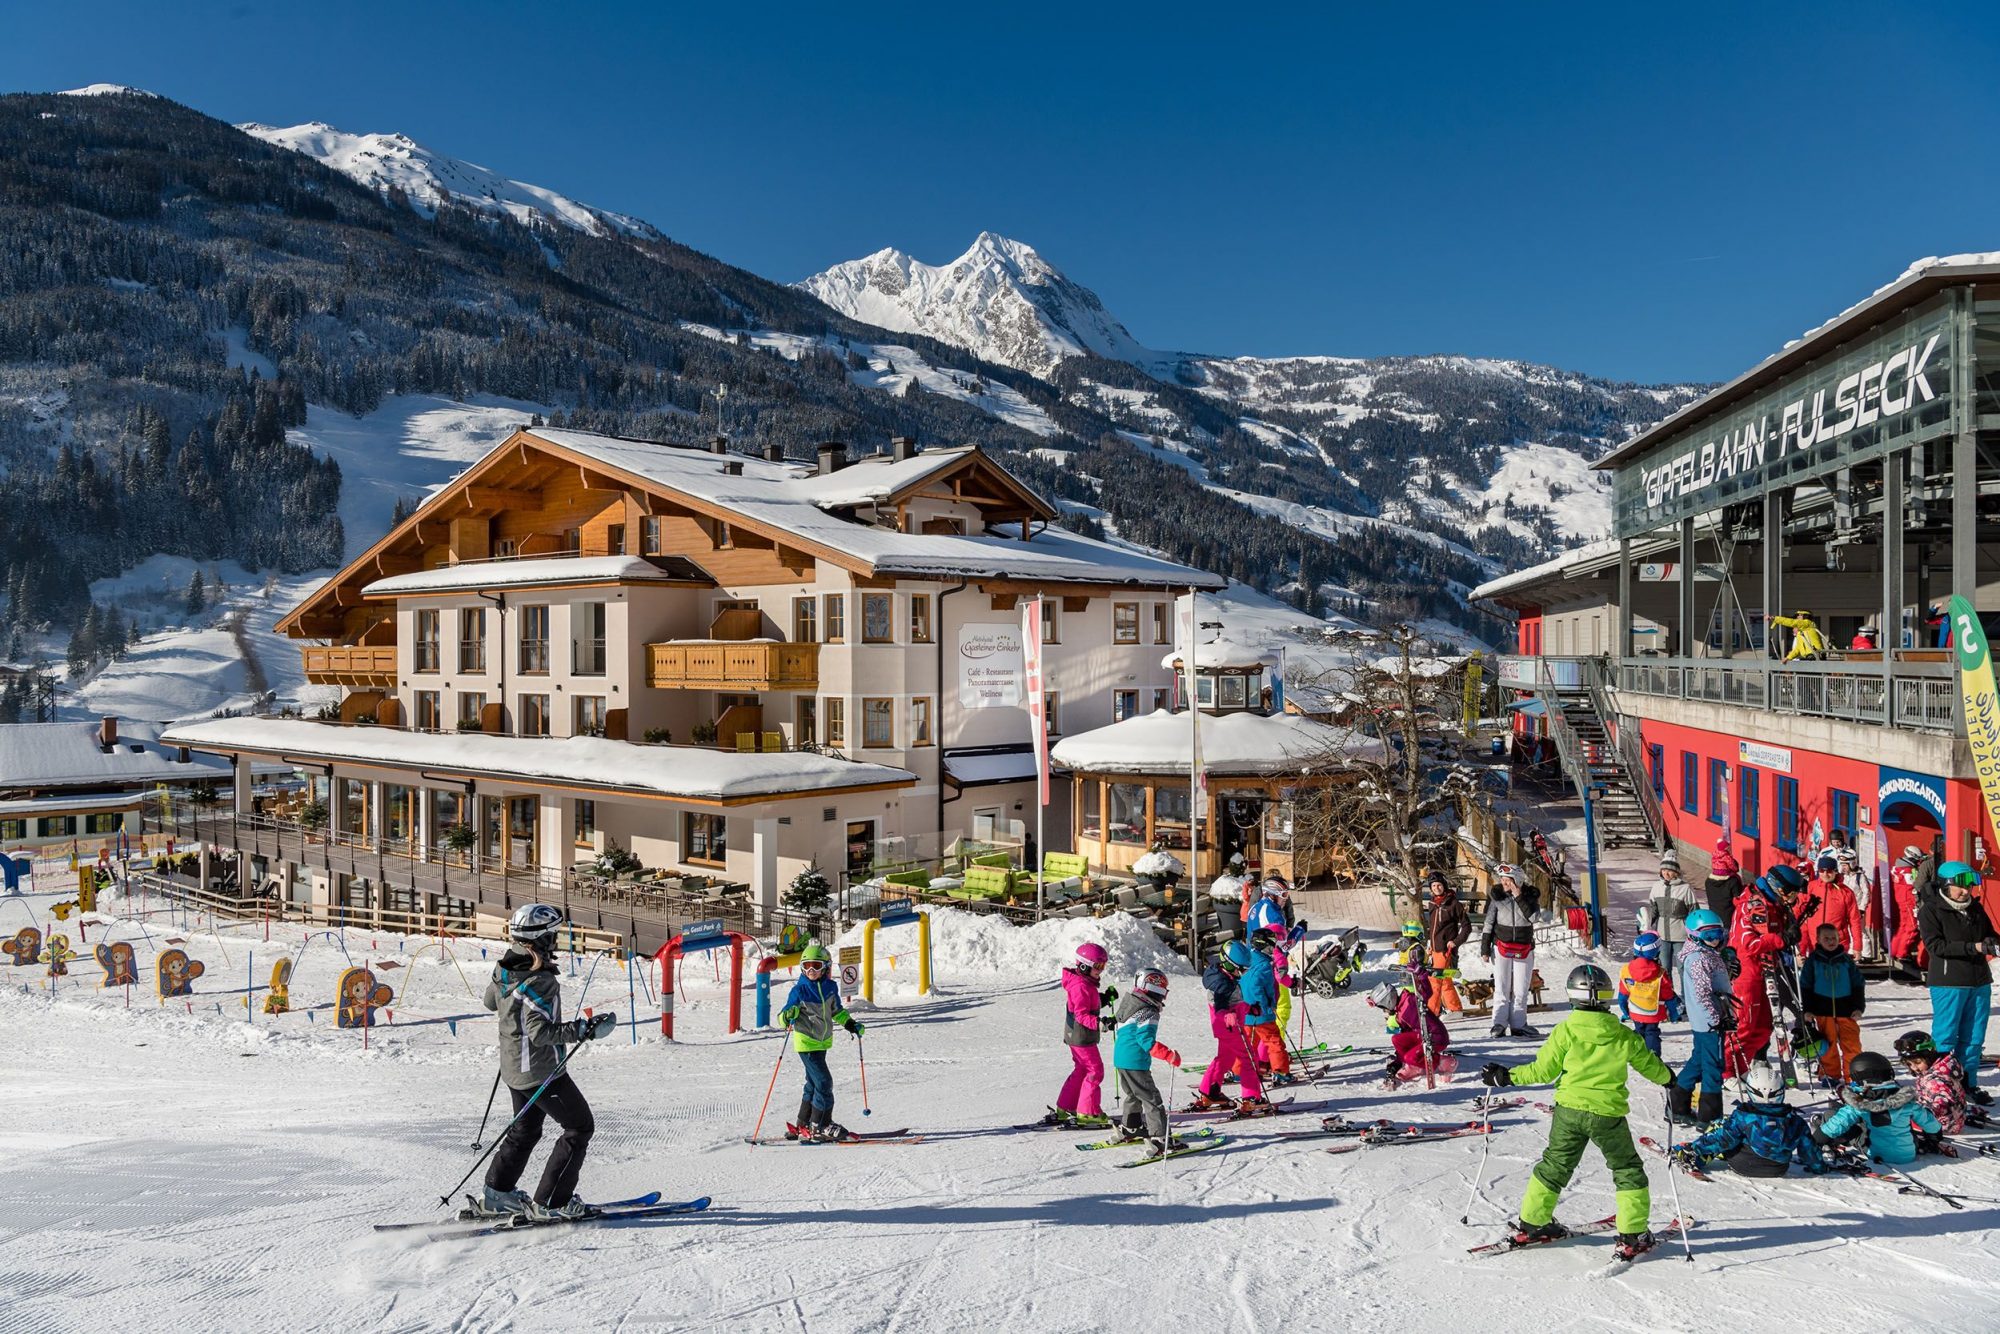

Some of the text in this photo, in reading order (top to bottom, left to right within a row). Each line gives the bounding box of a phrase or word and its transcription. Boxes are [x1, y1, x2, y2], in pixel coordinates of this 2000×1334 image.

[965, 641, 1020, 655] Gasteiner Einkehr
[968, 668, 980, 676] Café
[986, 668, 1013, 676] Restaurant
[1878, 777, 1946, 817] SKIKINDERGARTEN
[703, 923, 715, 931] Park
